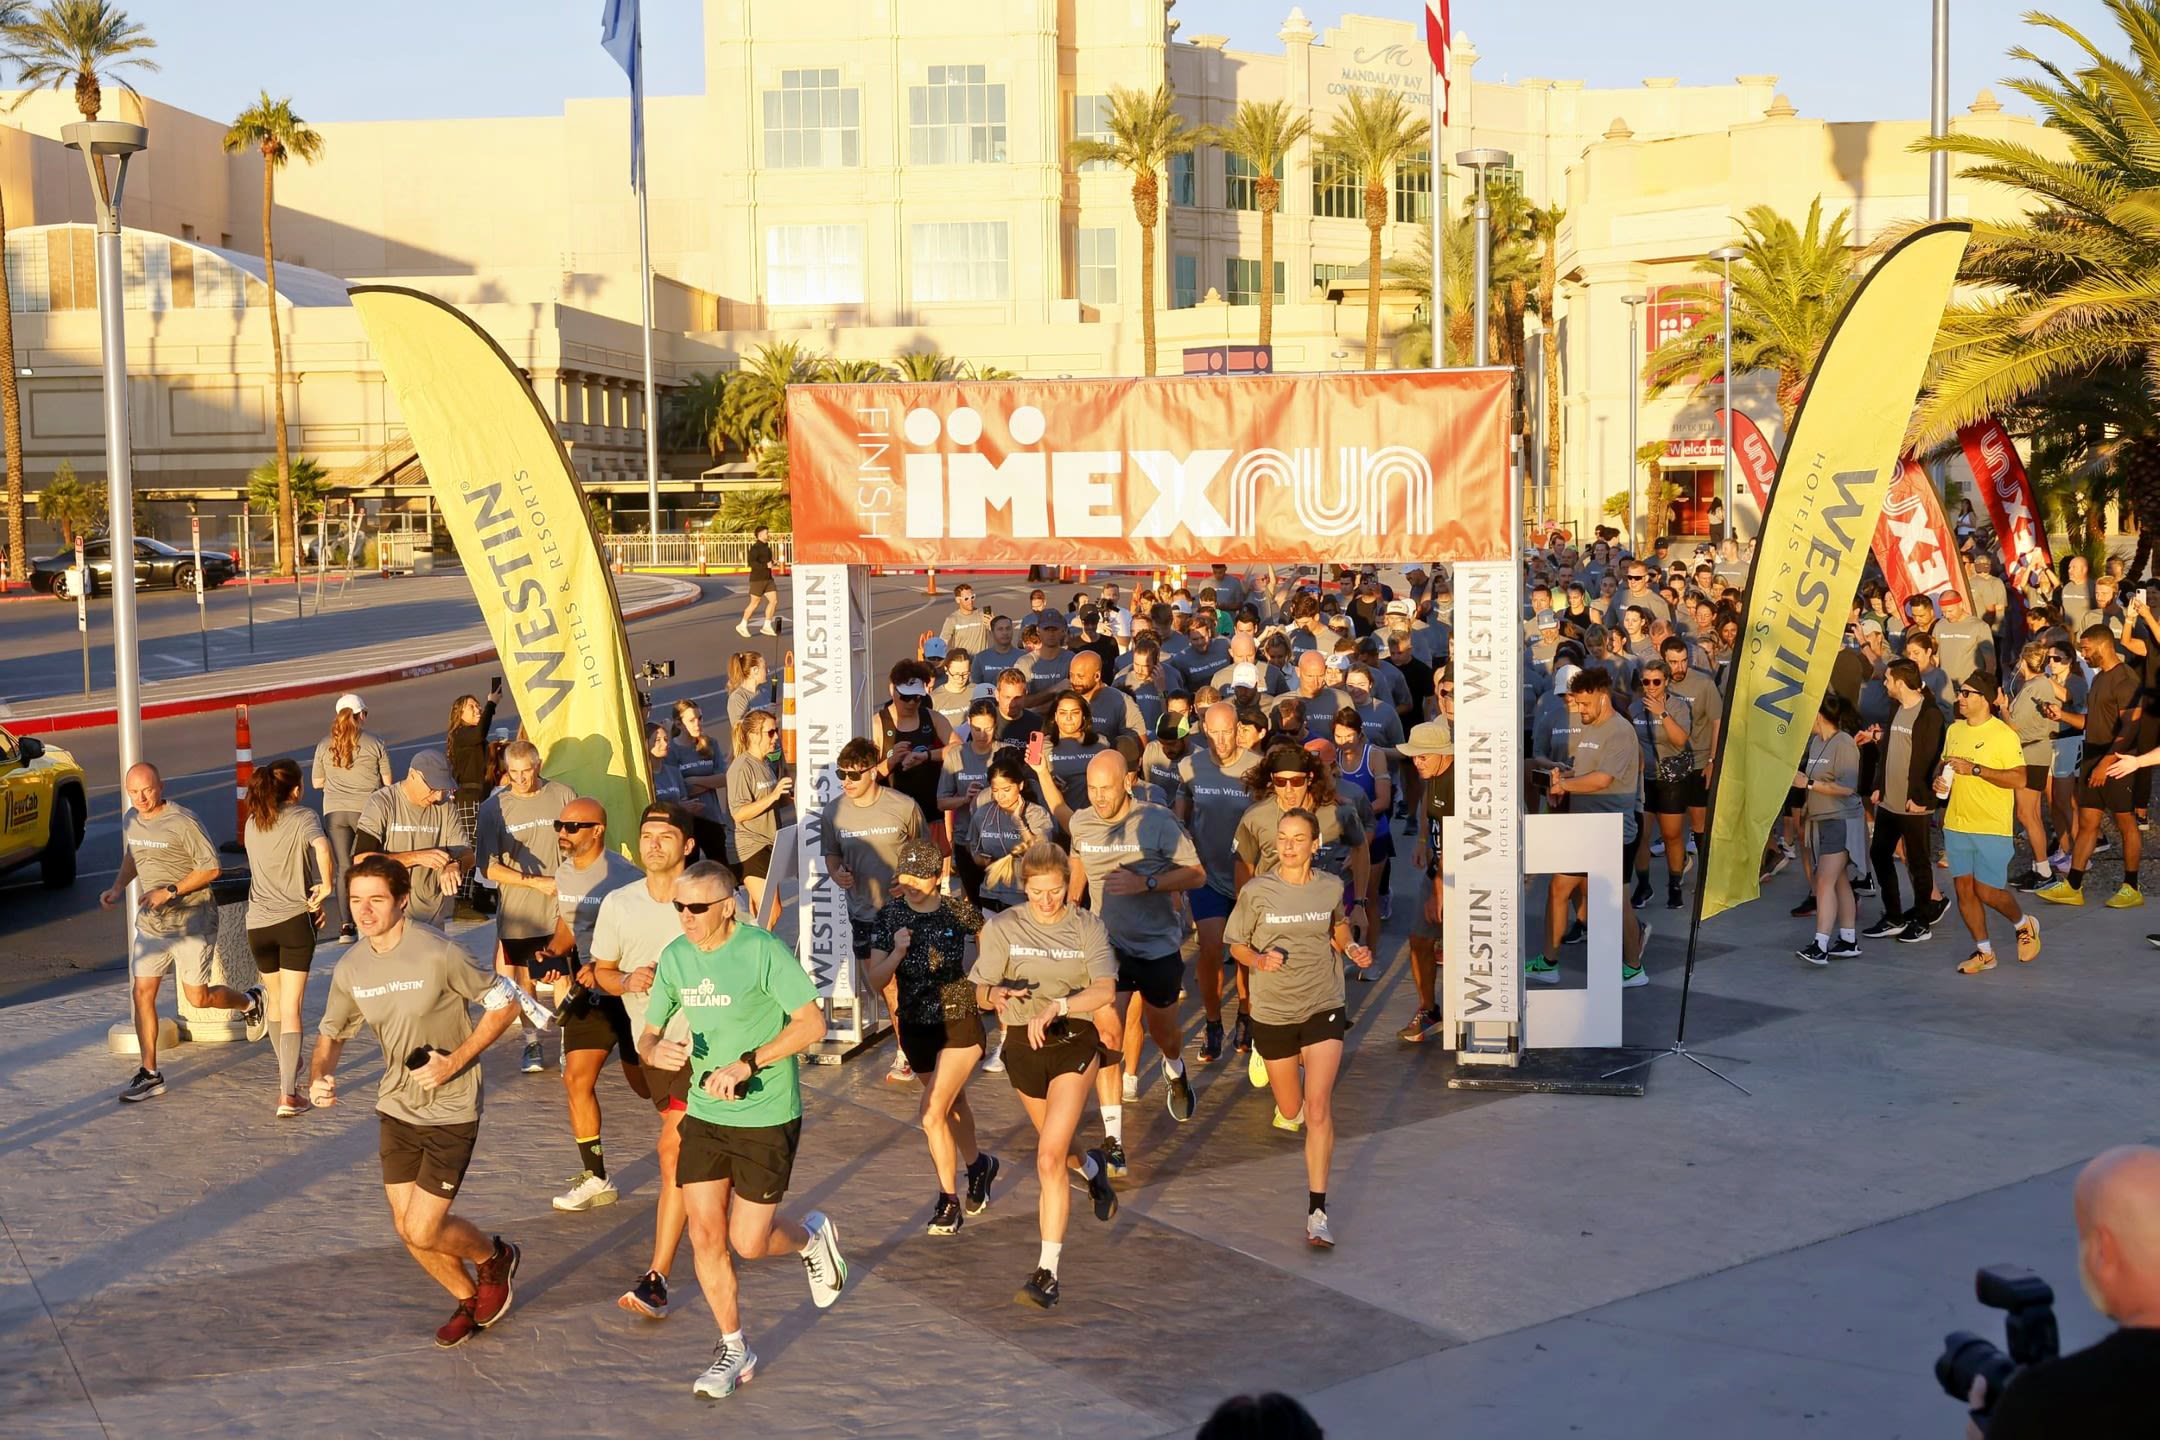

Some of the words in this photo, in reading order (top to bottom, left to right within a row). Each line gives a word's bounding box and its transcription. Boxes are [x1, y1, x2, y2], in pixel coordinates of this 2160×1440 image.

[1327, 83, 1399, 101] CONENN
[1402, 93, 1432, 106] CENTE
[1341, 67, 1400, 87] MANDALAY
[857, 407, 892, 539] FINISH
[514, 469, 564, 569] RESORTS
[1788, 452, 1826, 552] HOTELS
[559, 576, 571, 593] &
[1779, 562, 1791, 576] &
[565, 602, 602, 688] HOTELS
[1500, 888, 1509, 945] RESORTS
[389, 980, 424, 993] WESTIN
[1500, 964, 1509, 1013] HOTELS
